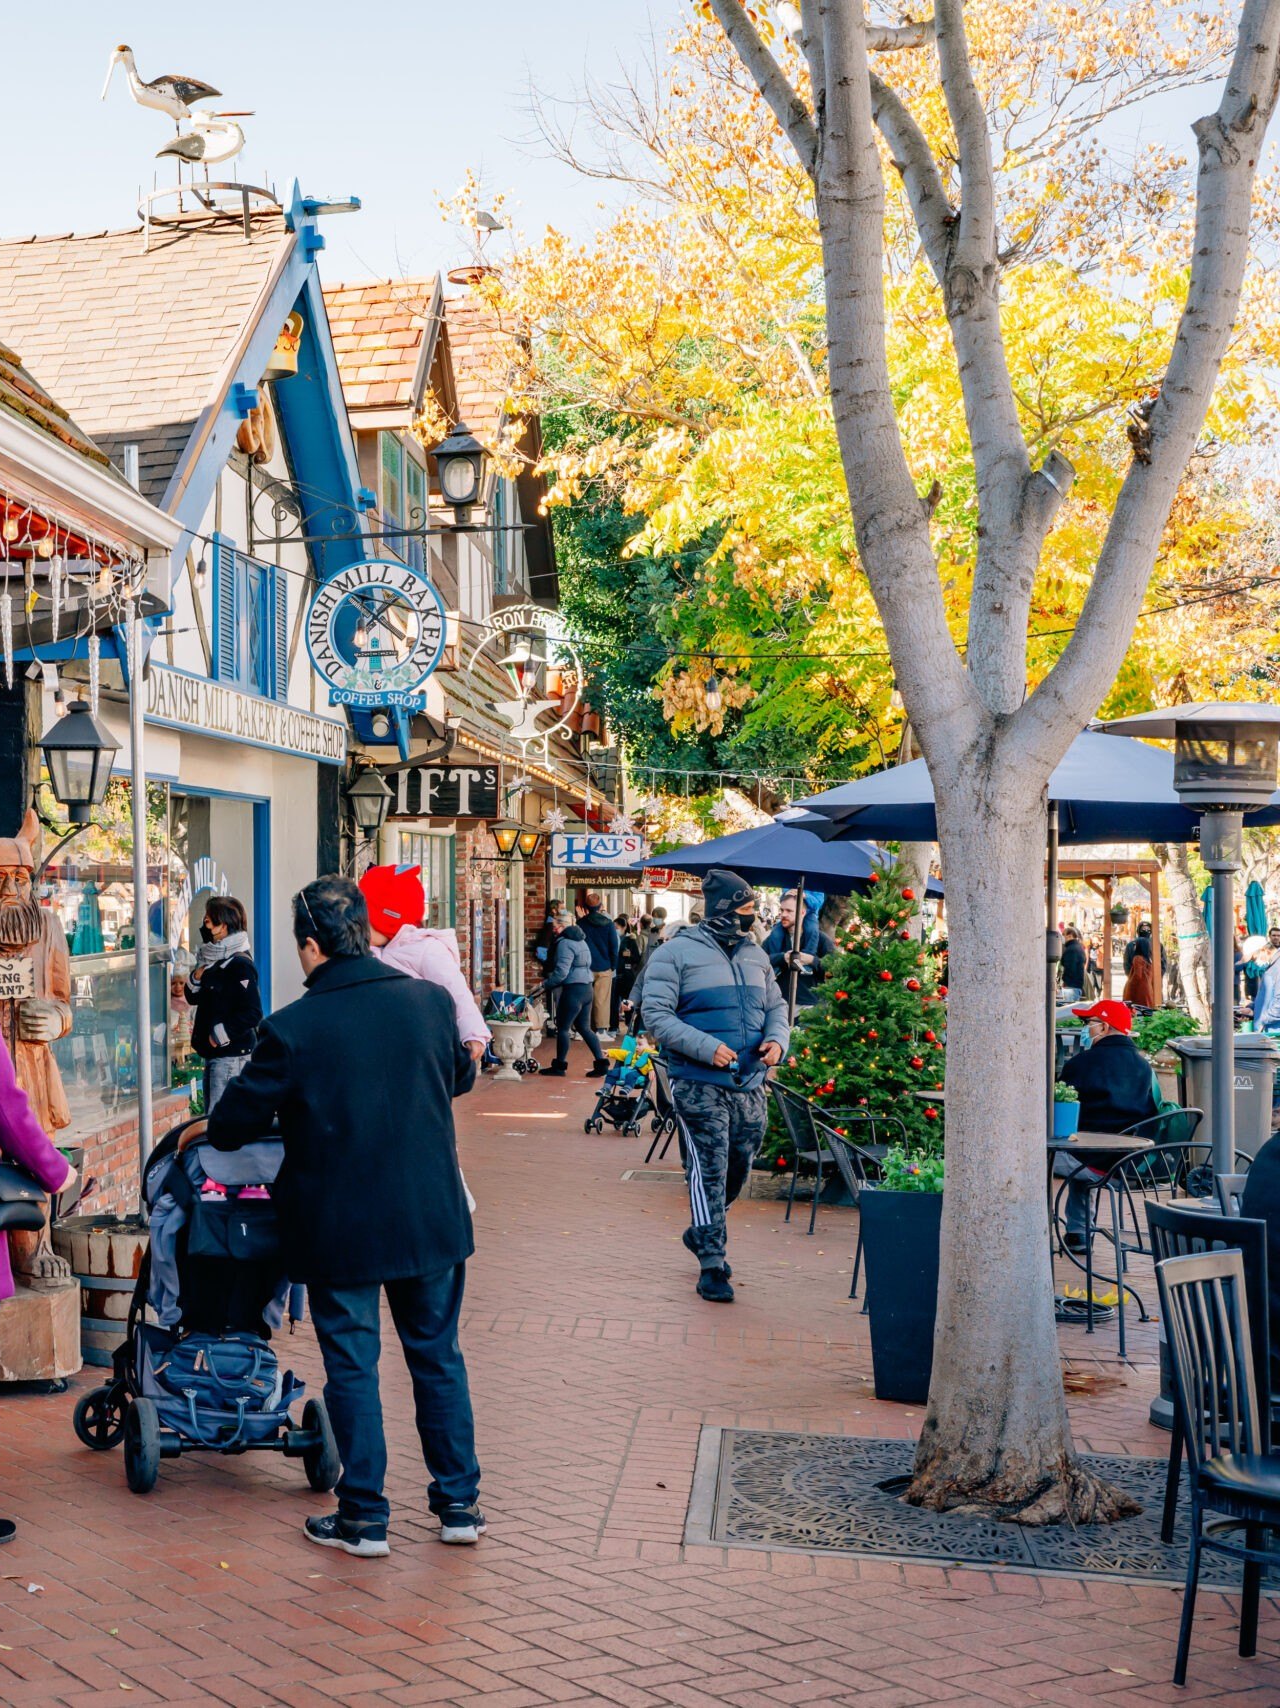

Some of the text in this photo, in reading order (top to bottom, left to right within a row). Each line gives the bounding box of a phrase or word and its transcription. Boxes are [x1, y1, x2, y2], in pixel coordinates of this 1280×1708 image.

[309, 564, 441, 679] DANISH MILL BAKERY
[331, 690, 421, 707] COFFEE SHOP
[373, 679, 383, 690] &
[145, 667, 344, 760] DANISH MILL BAKERY & COFFEE SHOP
[382, 768, 496, 815] IFTS
[558, 836, 636, 865] HATS
[193, 856, 217, 893] MILL
